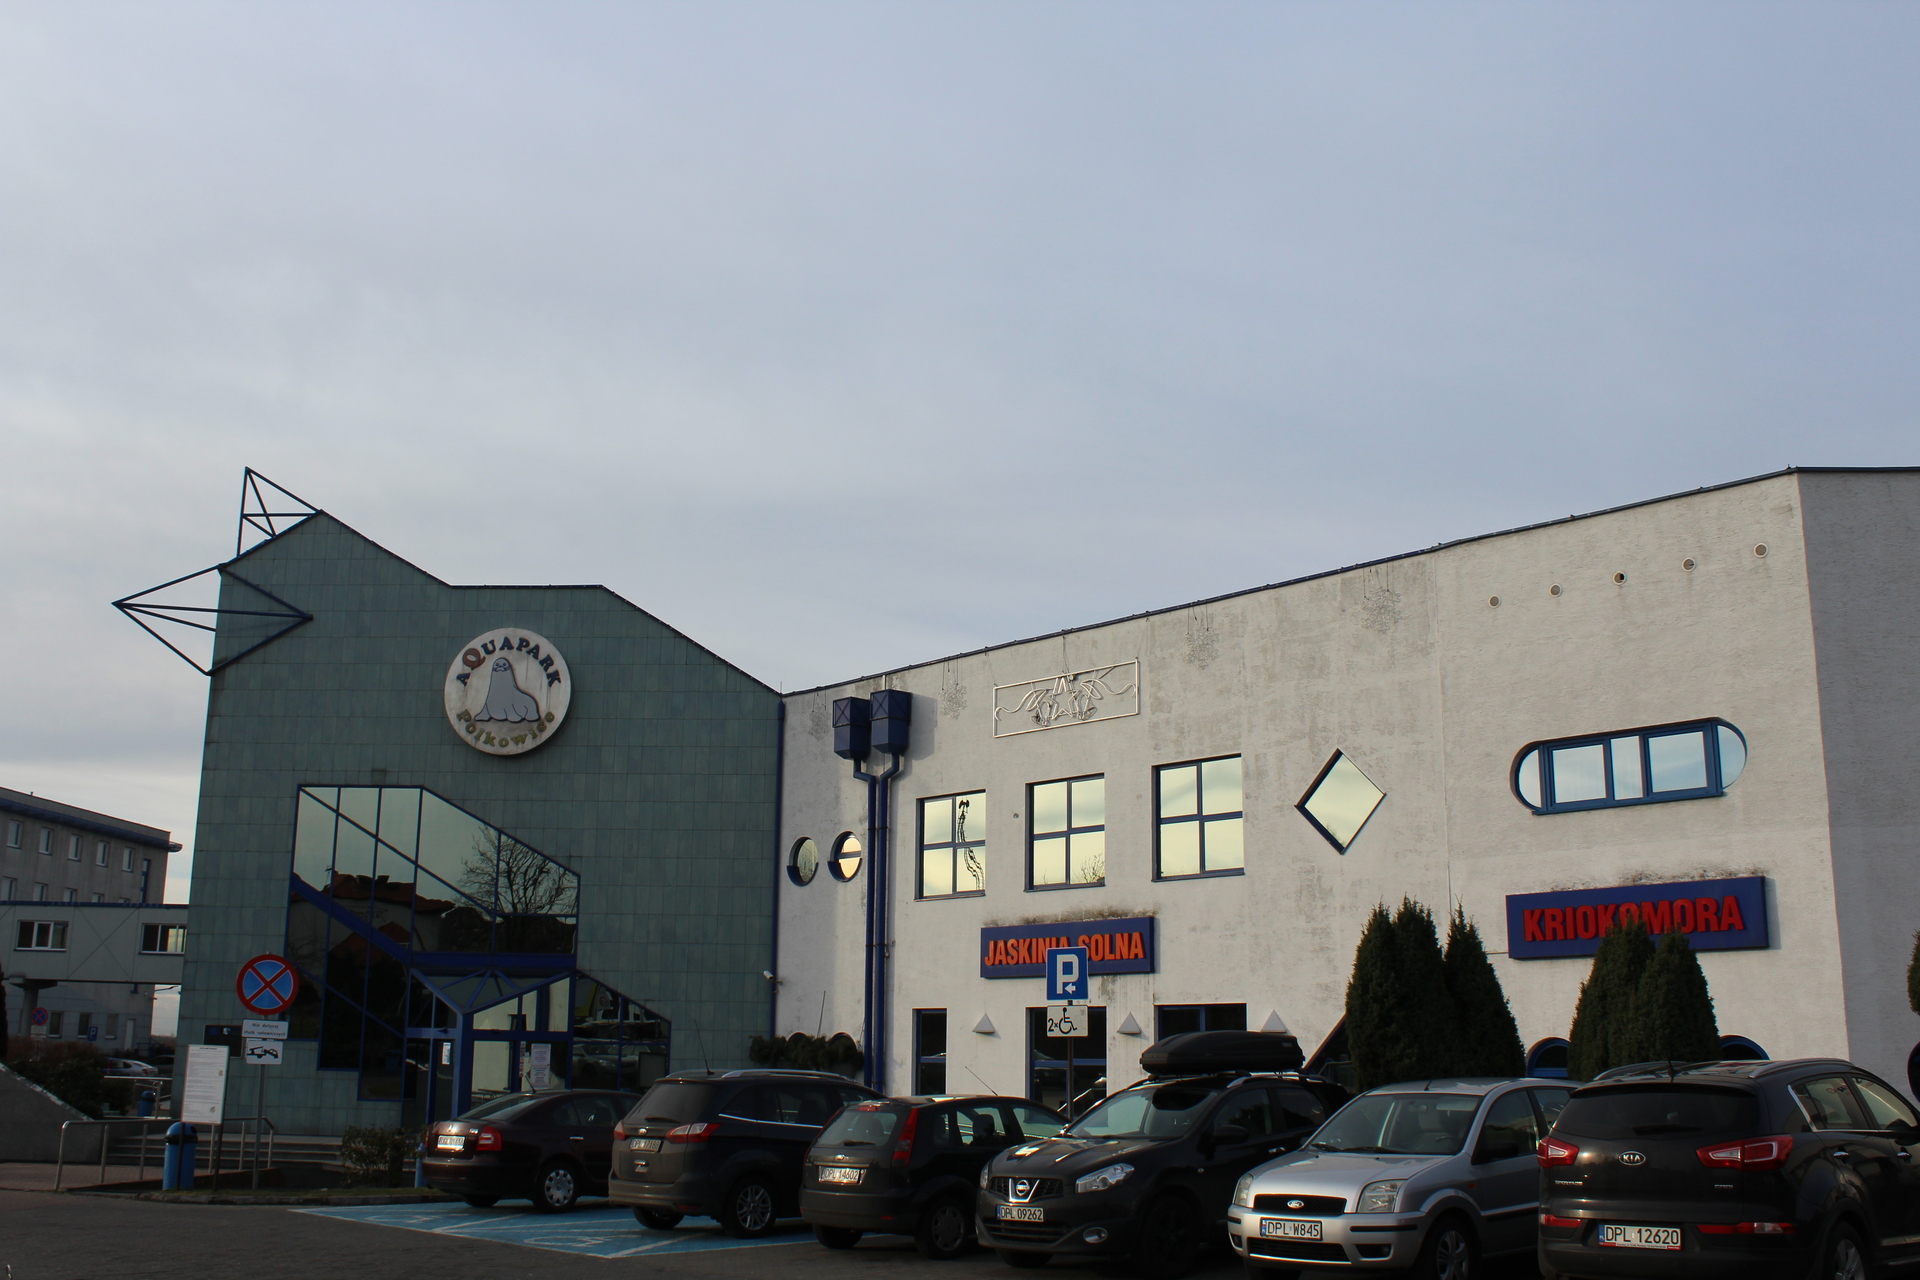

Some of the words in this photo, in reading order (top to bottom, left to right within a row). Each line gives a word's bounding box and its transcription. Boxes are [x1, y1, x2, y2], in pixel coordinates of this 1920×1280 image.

[456, 636, 561, 687] AQUAPARK
[457, 709, 555, 748] Polkowice
[1523, 895, 1745, 942] KRIOKOMORA
[1056, 954, 1079, 994] P
[1623, 1154, 1641, 1162] KIA
[825, 1168, 837, 1179] DPL
[839, 1169, 859, 1180] 14602
[1000, 1207, 1015, 1219] DPL
[1017, 1208, 1043, 1221] 09262
[1267, 1221, 1290, 1235] DPL
[1293, 1223, 1319, 1237] W845
[1605, 1226, 1631, 1242] DPL
[1637, 1228, 1680, 1245] 12620
